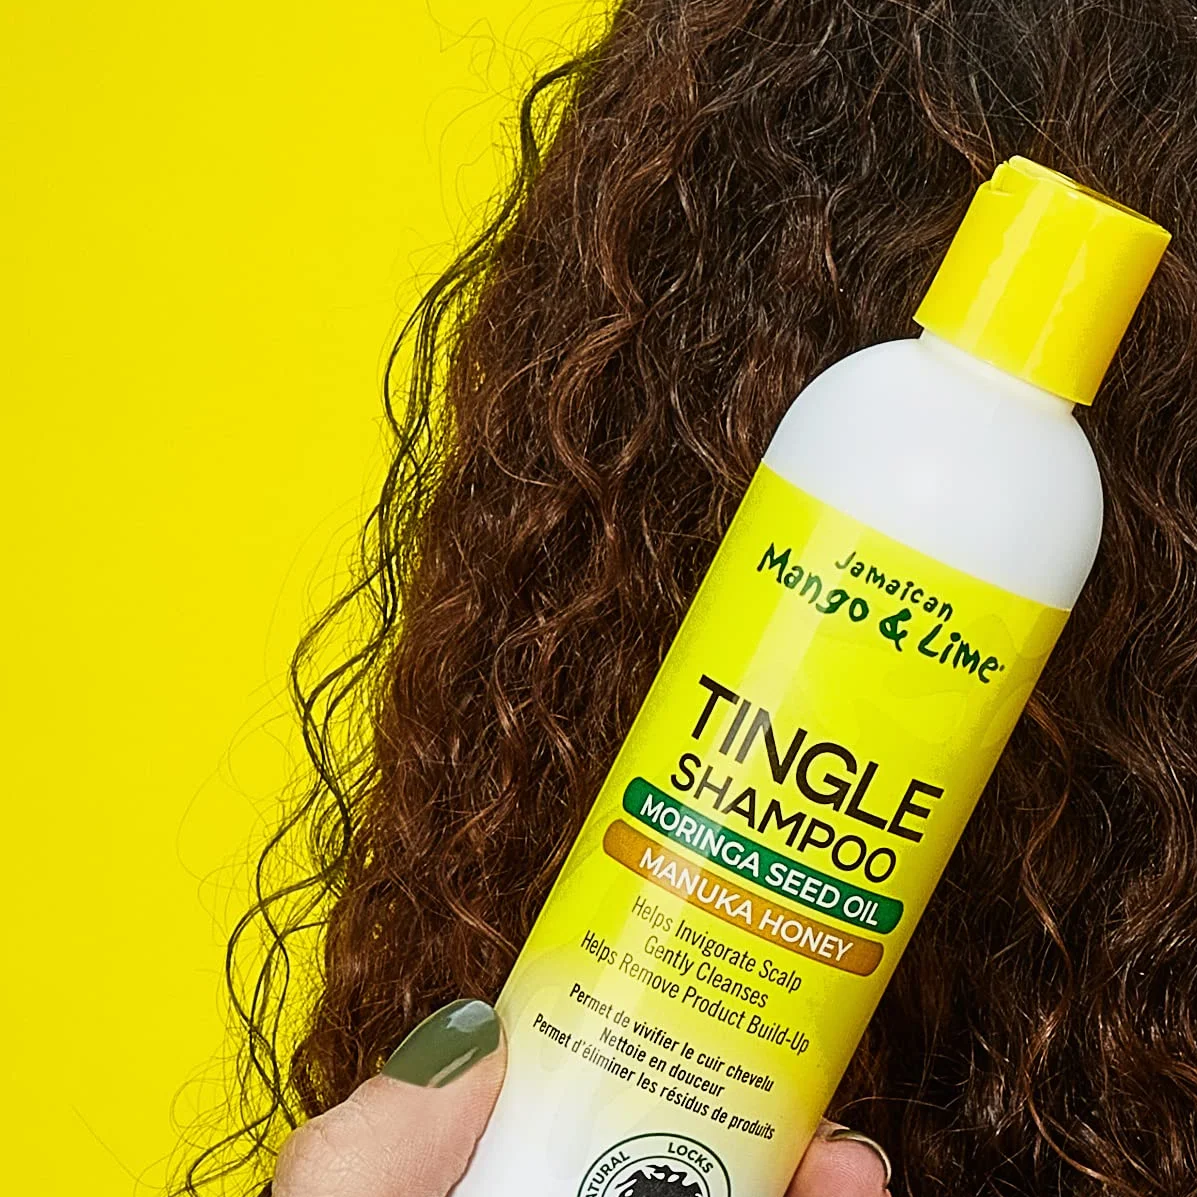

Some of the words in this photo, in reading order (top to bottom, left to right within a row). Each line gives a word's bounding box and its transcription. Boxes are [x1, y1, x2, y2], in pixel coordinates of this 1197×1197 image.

[757, 542, 869, 622] Mango
[879, 607, 912, 652] &
[917, 623, 1001, 684] Lime
[835, 551, 953, 621] Jamaican
[692, 674, 944, 843] TINGLE
[640, 794, 760, 878] MORINGA
[765, 863, 840, 909] SEED
[843, 896, 879, 926] OIL
[671, 753, 896, 883] SHAMPOO
[632, 896, 673, 933] Helps
[675, 920, 756, 972] Invigorate
[759, 960, 802, 994] Scalp
[639, 848, 752, 925] MANUKA
[758, 911, 853, 962] HONEY
[581, 930, 618, 965] Helps
[619, 953, 680, 998] Remove
[682, 986, 744, 1029] Product
[747, 1015, 810, 1056] Build-Up
[644, 936, 694, 976] Gently
[696, 962, 768, 1008] Cleanses
[533, 1013, 572, 1048] Permet
[572, 1039, 635, 1082] d'éliminer
[637, 1072, 658, 1094] les
[660, 1086, 710, 1117] résidus
[711, 1106, 729, 1124] de
[728, 1116, 776, 1141] produits
[570, 983, 612, 1019] Permet
[614, 1010, 630, 1028] de
[633, 1020, 680, 1052] vivifier
[681, 1042, 694, 1059] le
[697, 1050, 725, 1073] cuir
[726, 1063, 774, 1092] chevelu
[600, 1027, 647, 1062] Nettoie
[649, 1055, 672, 1073] en
[669, 1063, 725, 1097] douceur
[667, 1142, 714, 1174] LOCKS
